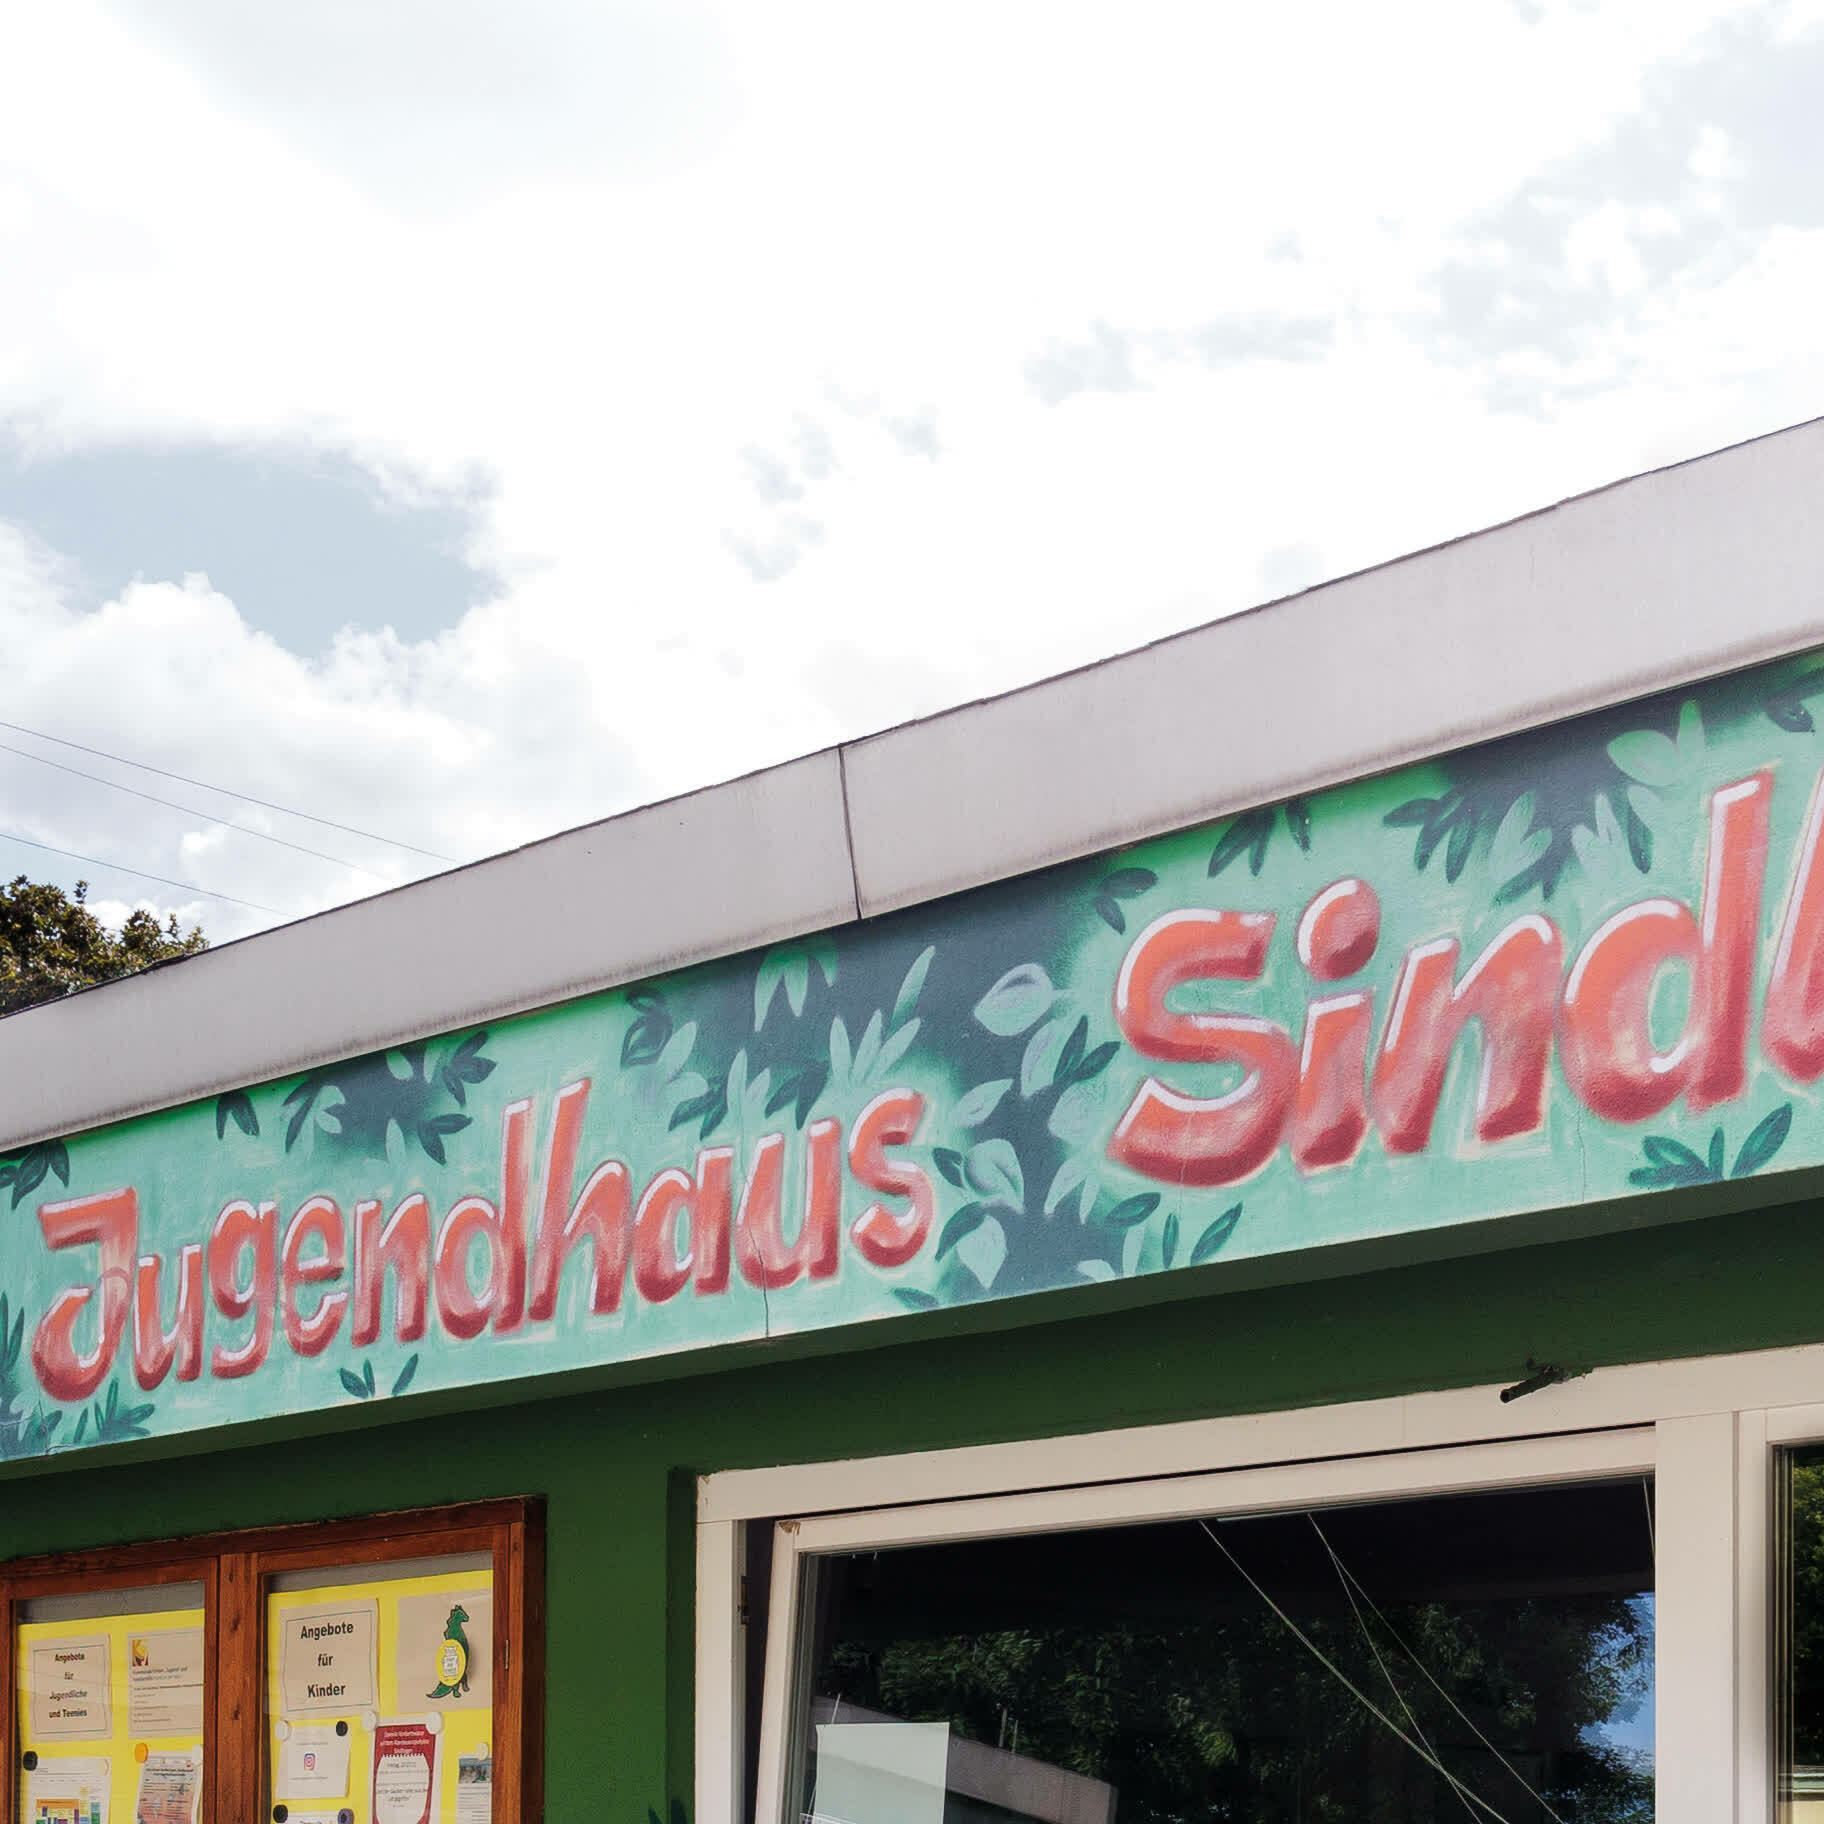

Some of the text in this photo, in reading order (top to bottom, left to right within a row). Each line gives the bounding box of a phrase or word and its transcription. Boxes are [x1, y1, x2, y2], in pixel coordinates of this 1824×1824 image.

[31, 1077, 935, 1401] Jugendhaus
[300, 1621, 354, 1641] Angebote
[55, 1653, 85, 1663] Angebote
[317, 1653, 334, 1667] für
[64, 1671, 74, 1681] für
[50, 1690, 87, 1701] Jugendliche
[307, 1683, 346, 1698] Kinder
[48, 1708, 88, 1719] und Teenies
